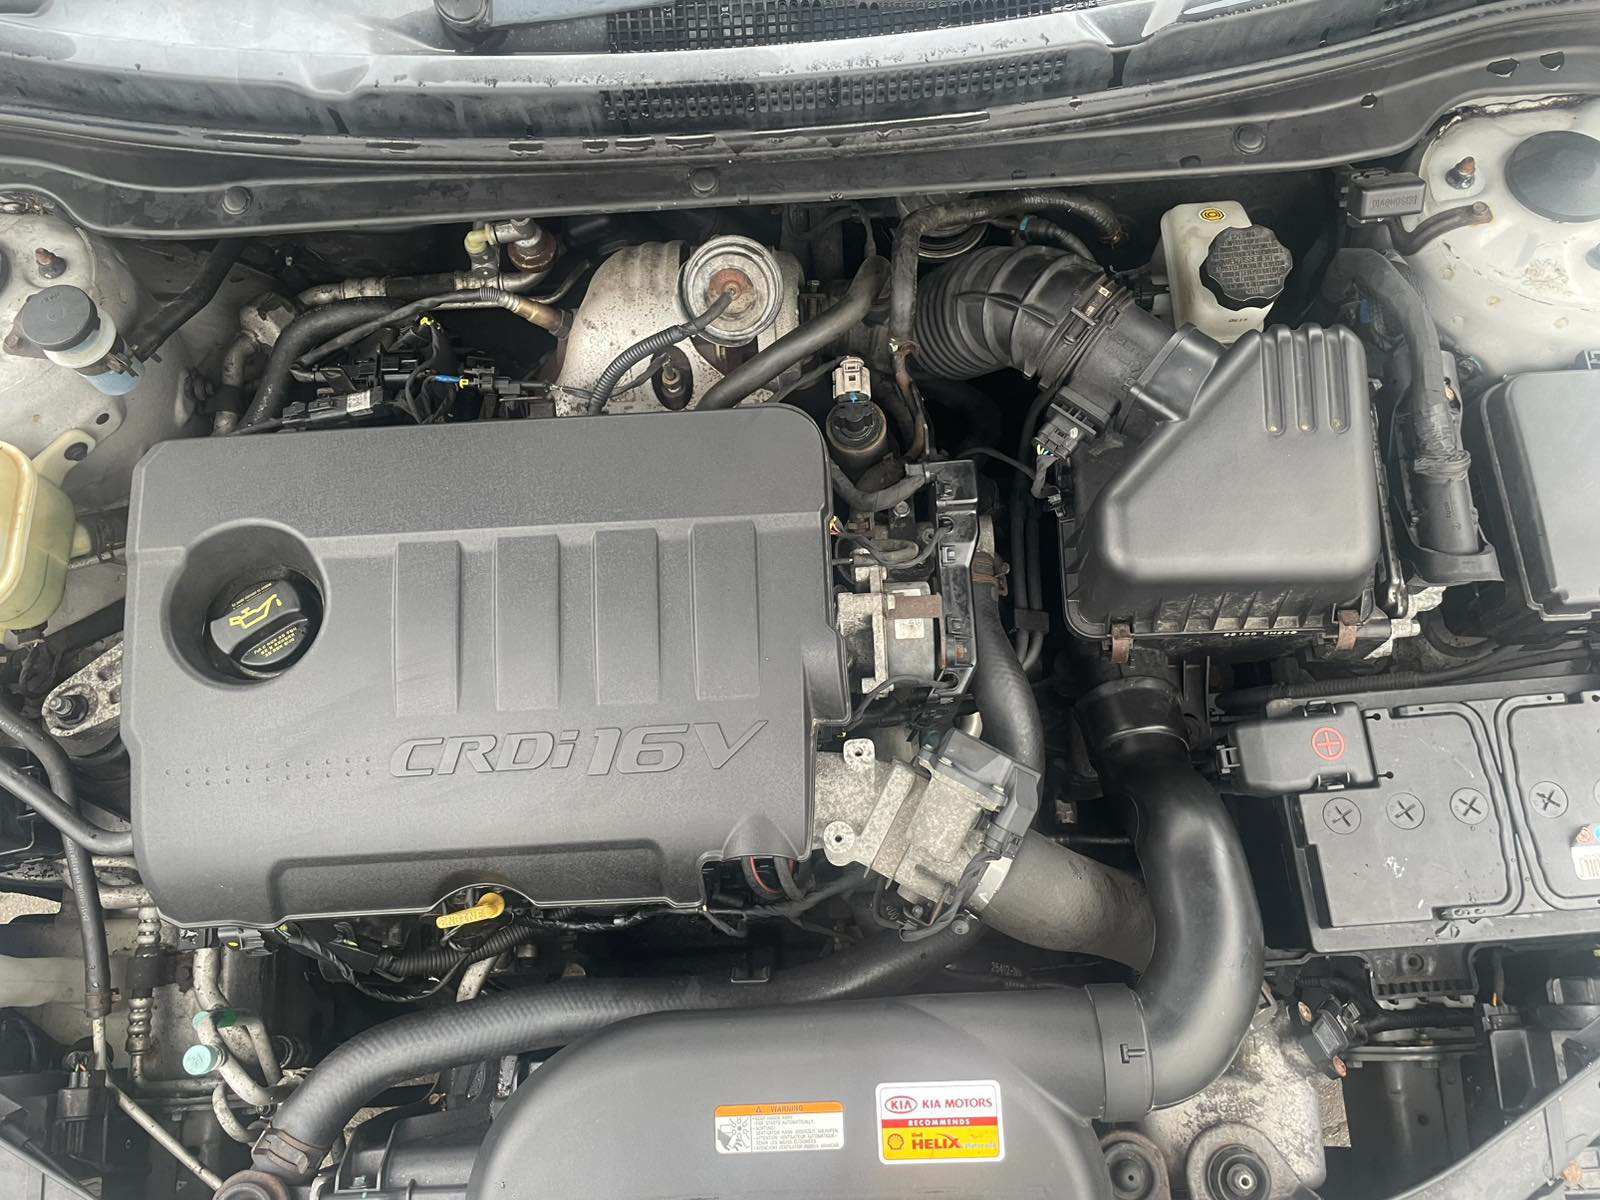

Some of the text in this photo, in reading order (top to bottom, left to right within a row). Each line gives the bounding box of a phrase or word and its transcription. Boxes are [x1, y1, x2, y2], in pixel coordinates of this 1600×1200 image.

[922, 1097, 993, 1109] KIA MOTORS
[908, 1118, 971, 1127] RECOMMENDS
[911, 1136, 961, 1150] HELIX
